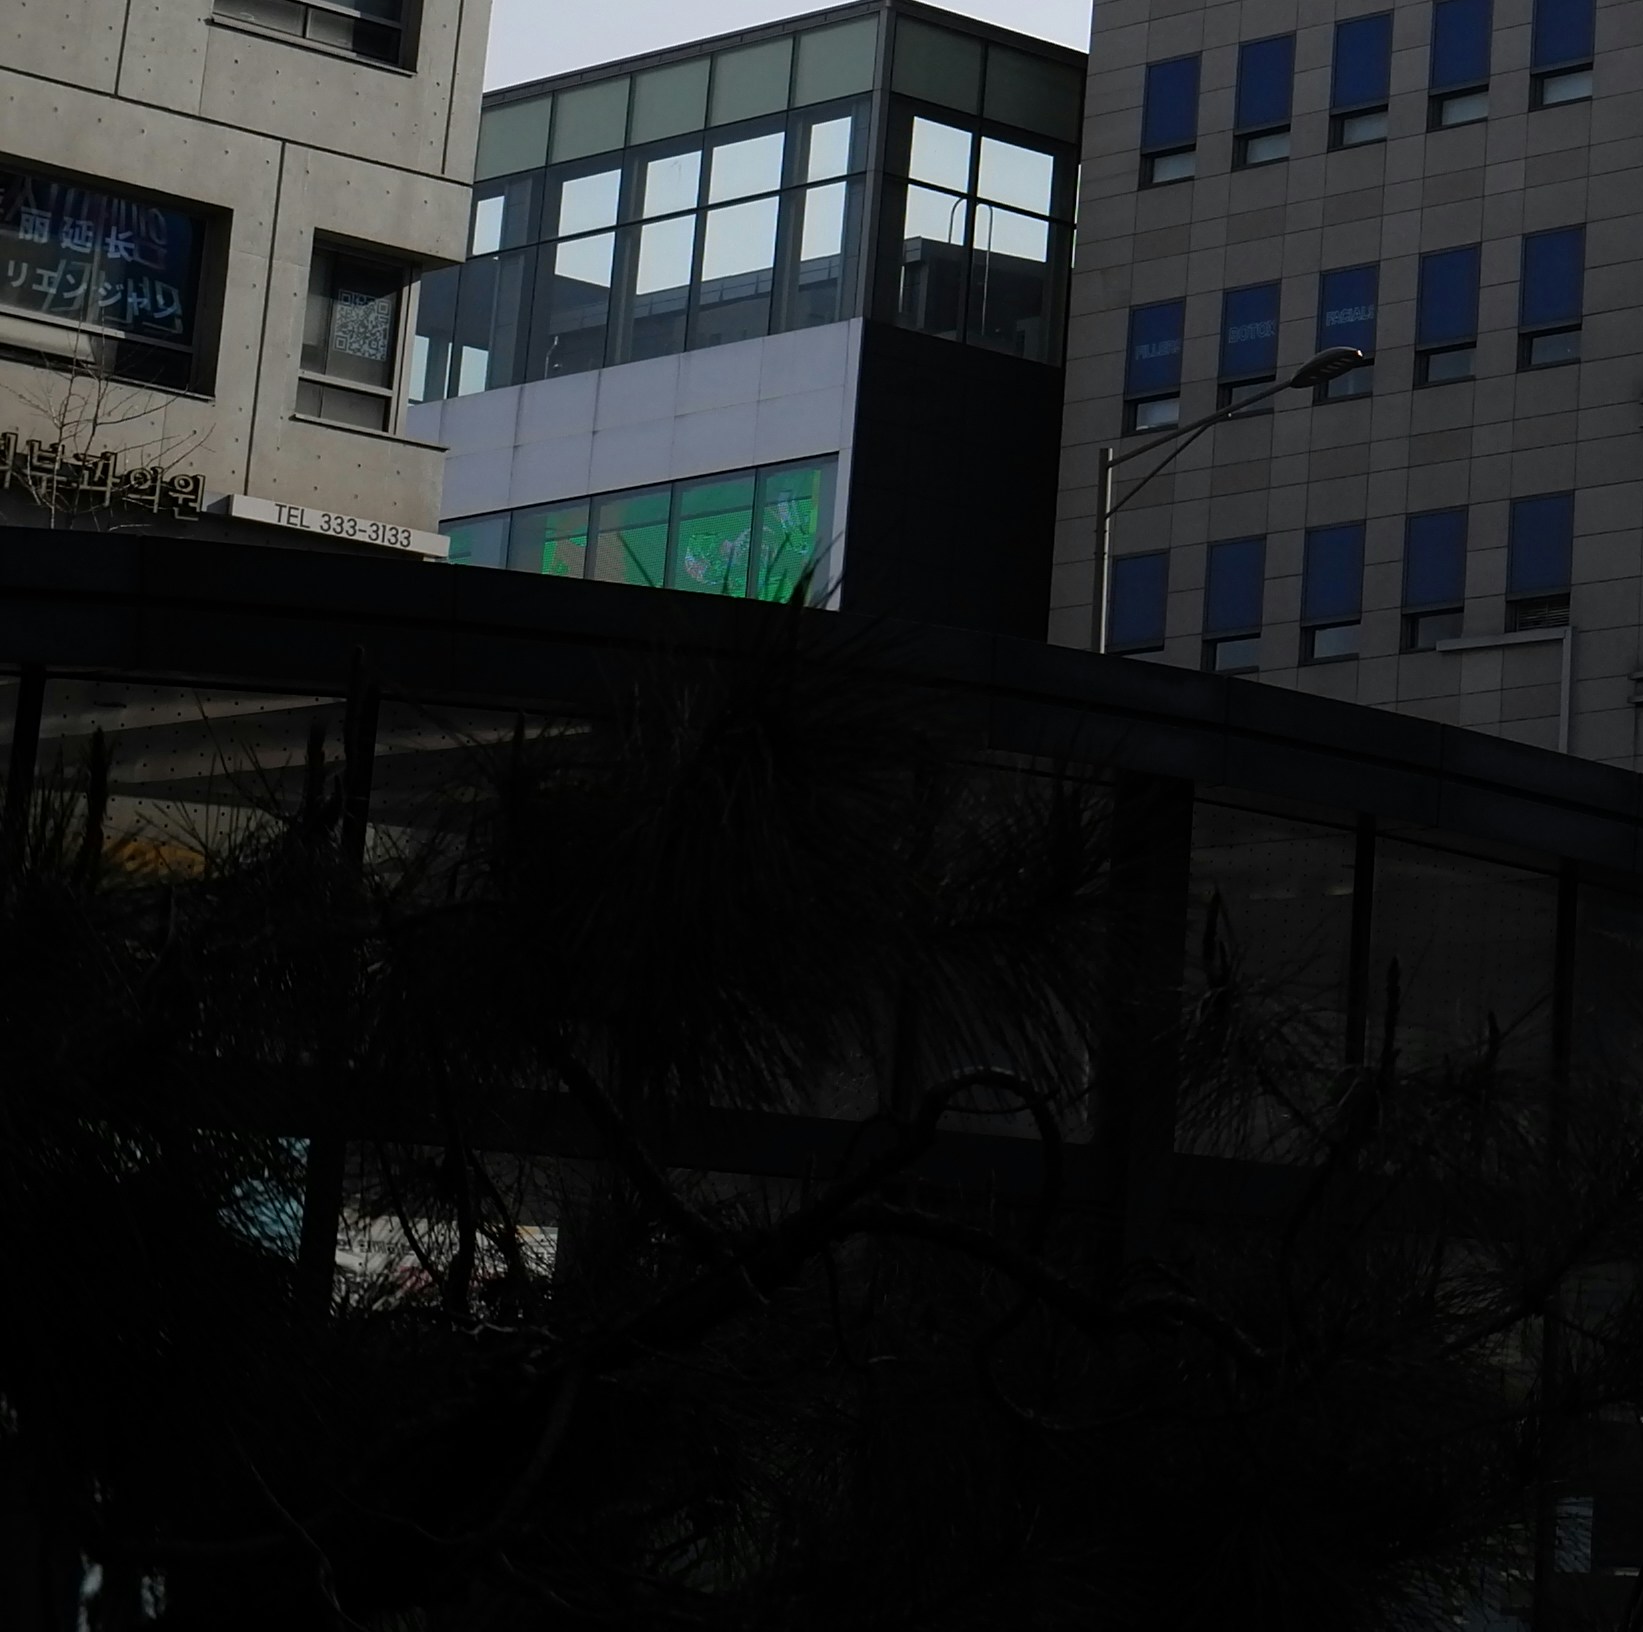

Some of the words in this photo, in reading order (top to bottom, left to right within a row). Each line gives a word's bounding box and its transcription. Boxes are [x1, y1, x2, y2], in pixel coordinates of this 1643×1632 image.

[0, 186, 135, 262] 丽延长
[7, 259, 179, 318] リエンジャン
[275, 503, 310, 528] TEL
[320, 513, 412, 548] 333-3133
